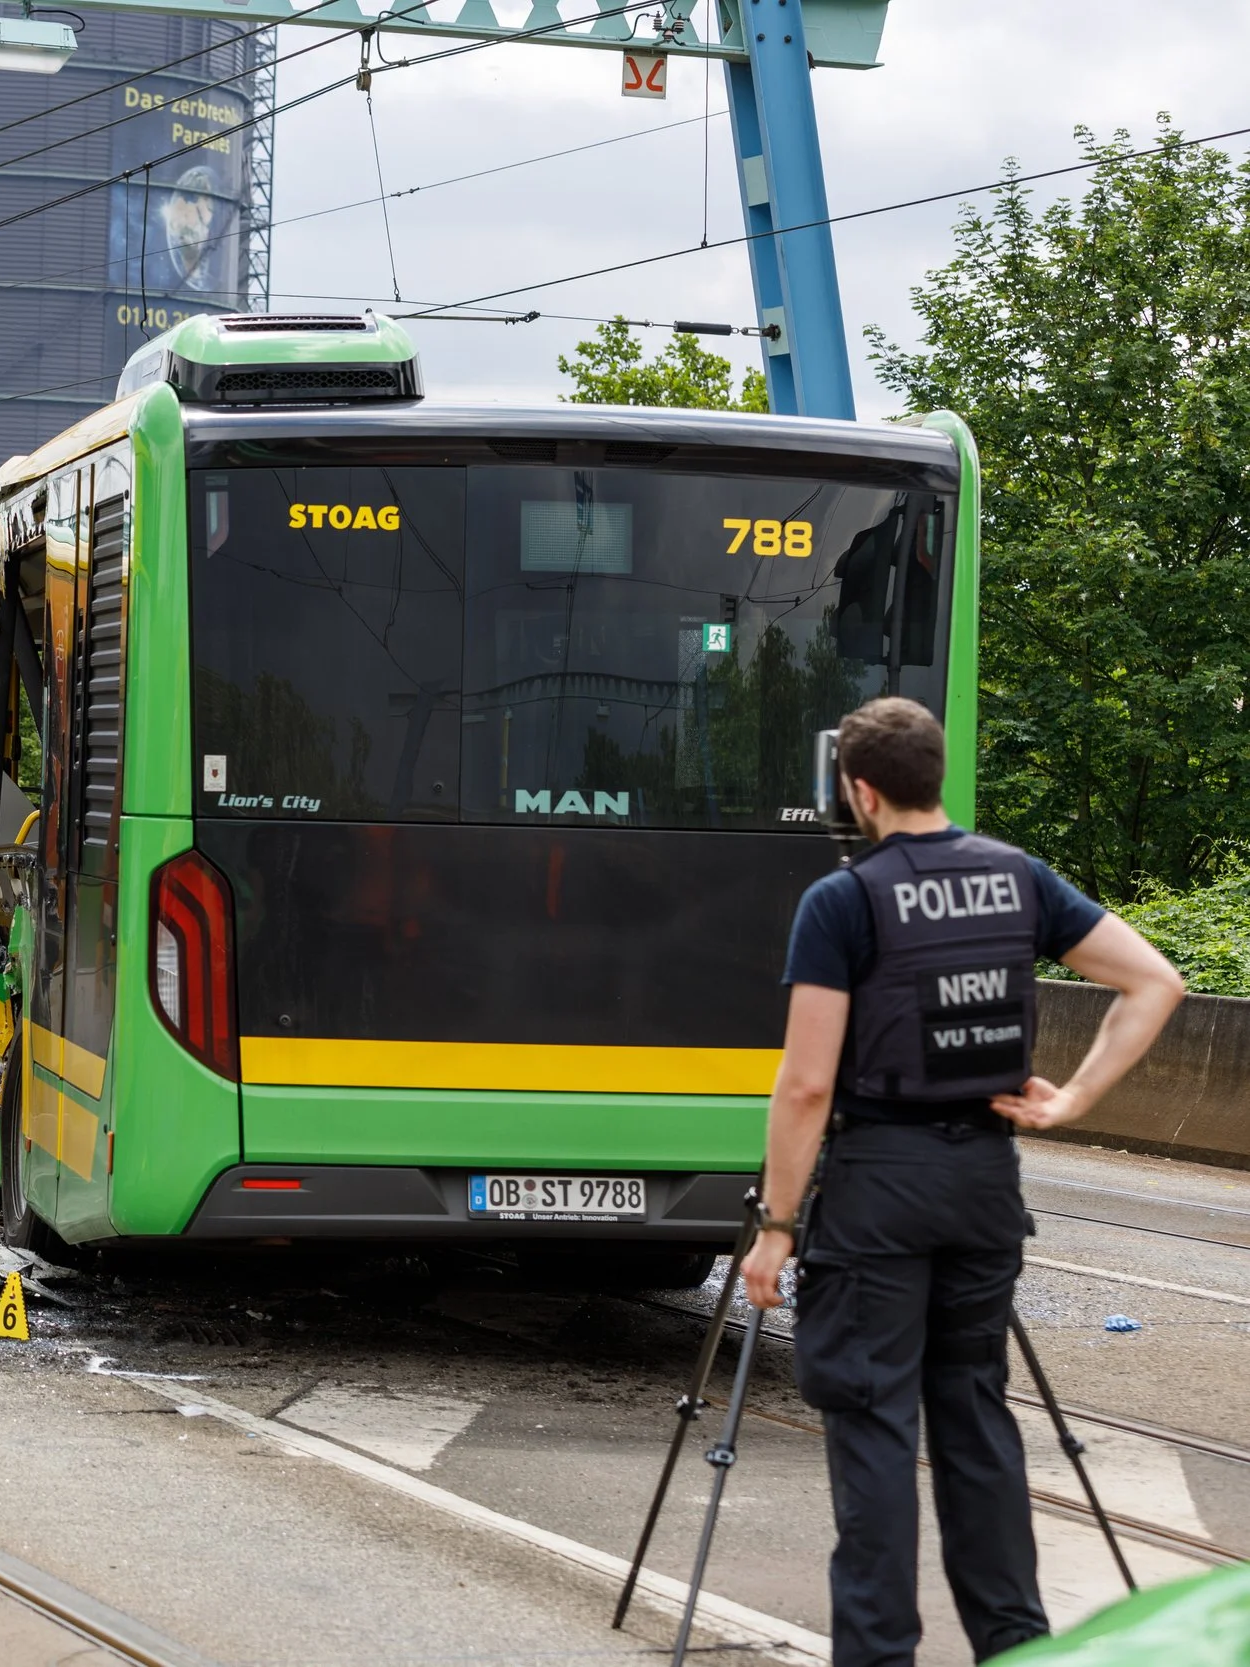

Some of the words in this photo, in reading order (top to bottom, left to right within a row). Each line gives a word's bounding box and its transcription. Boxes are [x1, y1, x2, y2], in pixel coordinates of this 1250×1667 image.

[125, 87, 164, 111] Das
[289, 503, 400, 531] STOAG
[723, 518, 813, 557] 788
[218, 793, 274, 808] Lion's
[282, 795, 321, 812] City
[515, 789, 629, 815] MAN
[780, 808, 818, 822] Effi
[893, 872, 1022, 924] POLIZEI
[937, 967, 1008, 1007] NRW
[933, 1028, 967, 1049] VU
[971, 1024, 1021, 1044] Team
[475, 1195, 482, 1204] D
[489, 1179, 521, 1207] OB
[541, 1179, 572, 1207] ST
[579, 1180, 642, 1209] 9788
[499, 1212, 526, 1220] STOAG
[582, 1214, 618, 1222] Innovation
[2, 1302, 18, 1331] 6
